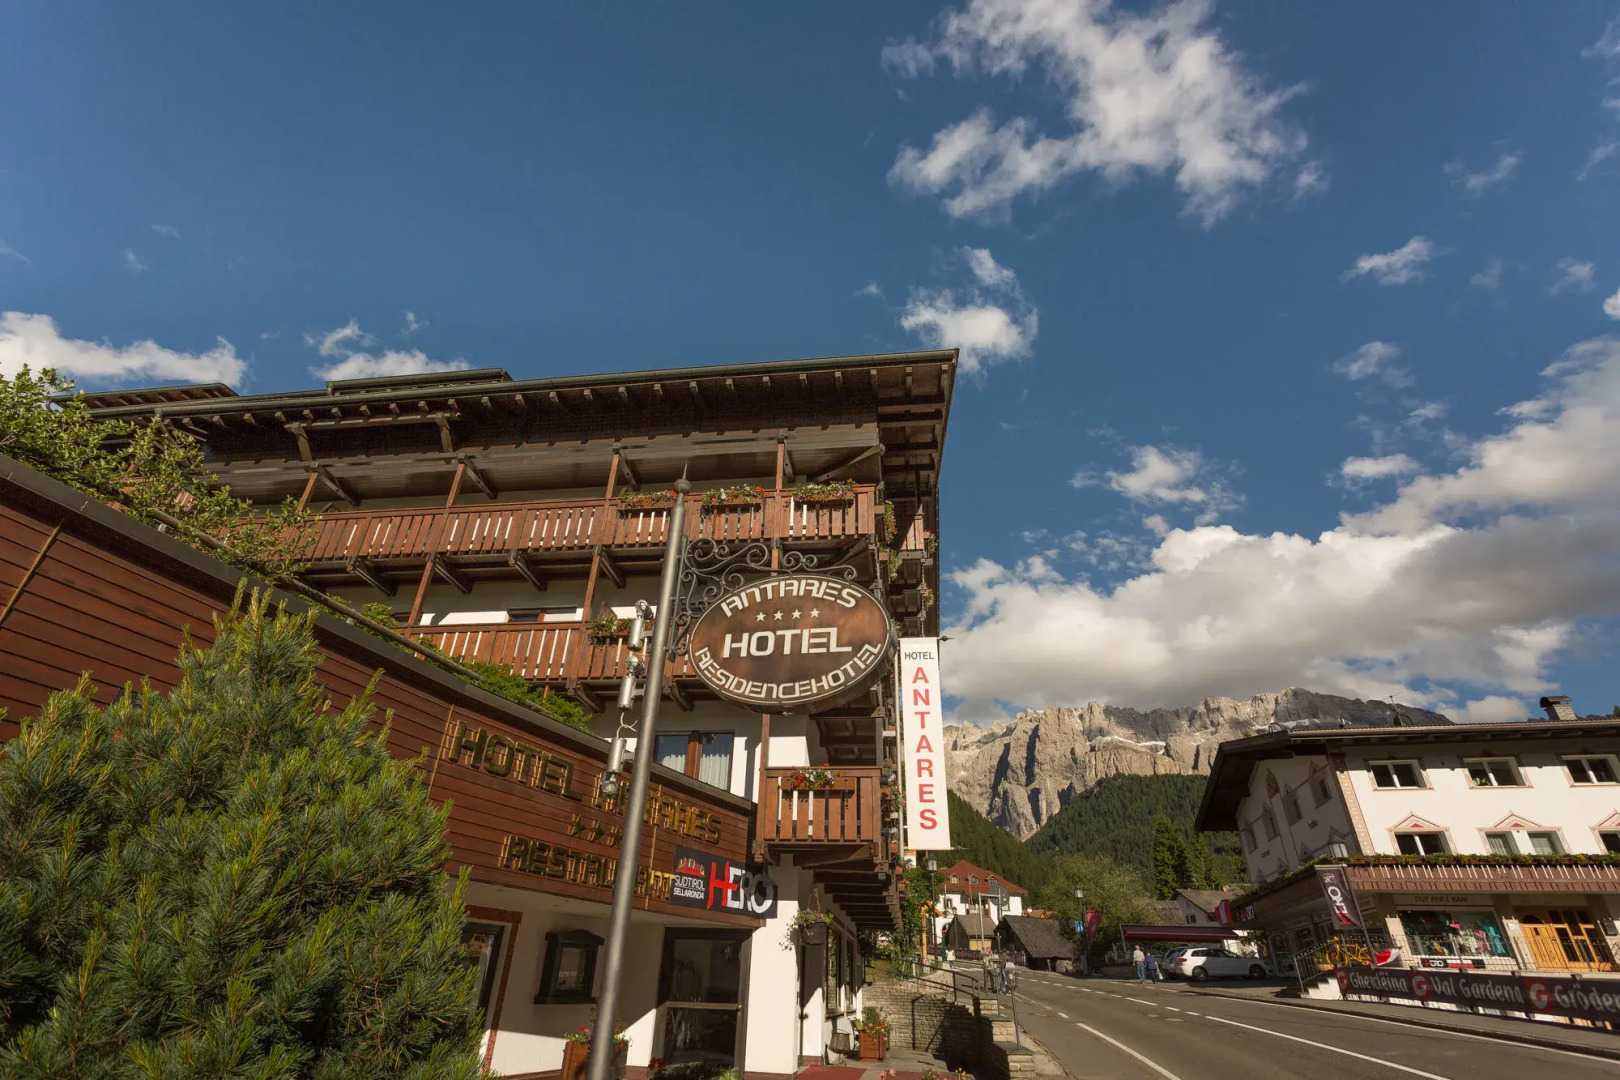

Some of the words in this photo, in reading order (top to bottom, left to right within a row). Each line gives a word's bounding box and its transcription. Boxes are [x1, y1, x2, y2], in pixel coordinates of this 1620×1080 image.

[720, 579, 862, 617] ANTARES
[722, 627, 852, 658] HOTEL
[904, 651, 934, 660] HOTEL
[695, 643, 881, 699] RESIDENCEHOTEL
[448, 719, 583, 802] HOTEL
[912, 667, 937, 830] ANTARES
[673, 887, 705, 900] SELLARONDA
[707, 860, 774, 914] HERO
[1430, 976, 1457, 997] Val
[1460, 978, 1526, 1004] Gardena
